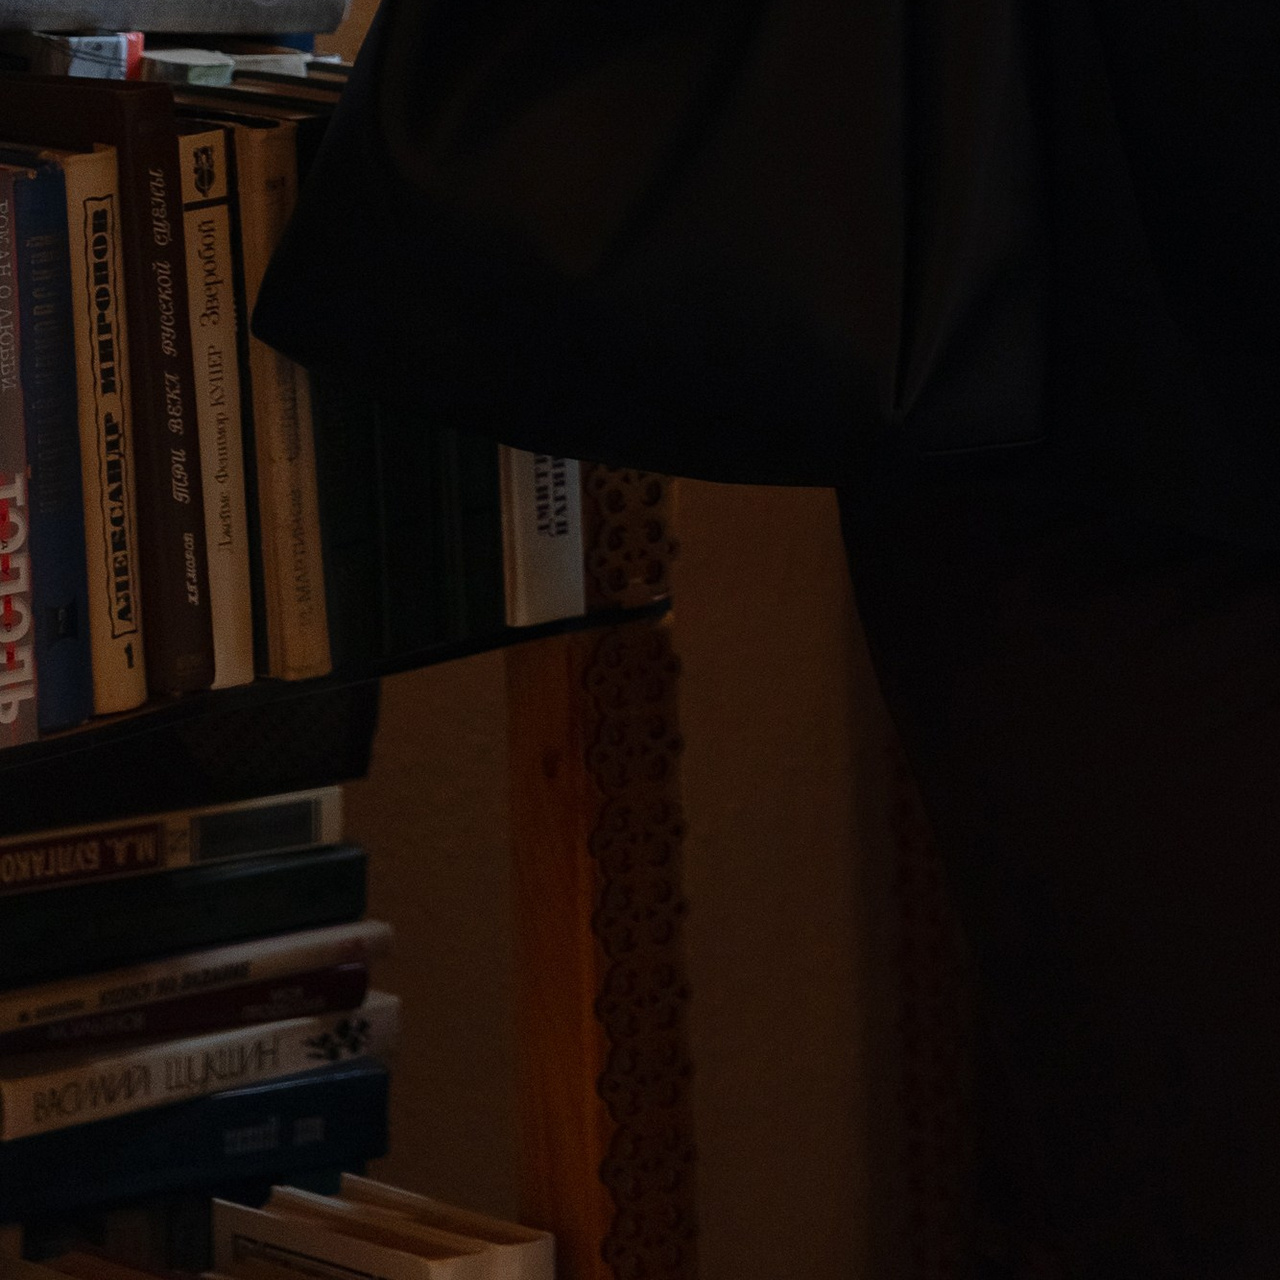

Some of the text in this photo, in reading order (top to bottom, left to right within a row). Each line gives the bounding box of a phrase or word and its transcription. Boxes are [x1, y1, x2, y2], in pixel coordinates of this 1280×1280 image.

[1, 309, 17, 392] ЛЮБВИ
[91, 208, 116, 396] МИРОНОВ
[149, 168, 191, 504] ТРИ ВЕКА РУССКОЙ СЦЕНЫ
[198, 219, 234, 551] Джеймс Фенимор КУПЕР Зверобой
[103, 412, 134, 624] АЛЕКСАНДР
[33, 1035, 283, 1123] ВАСИЛИЙ ШУКШИН
